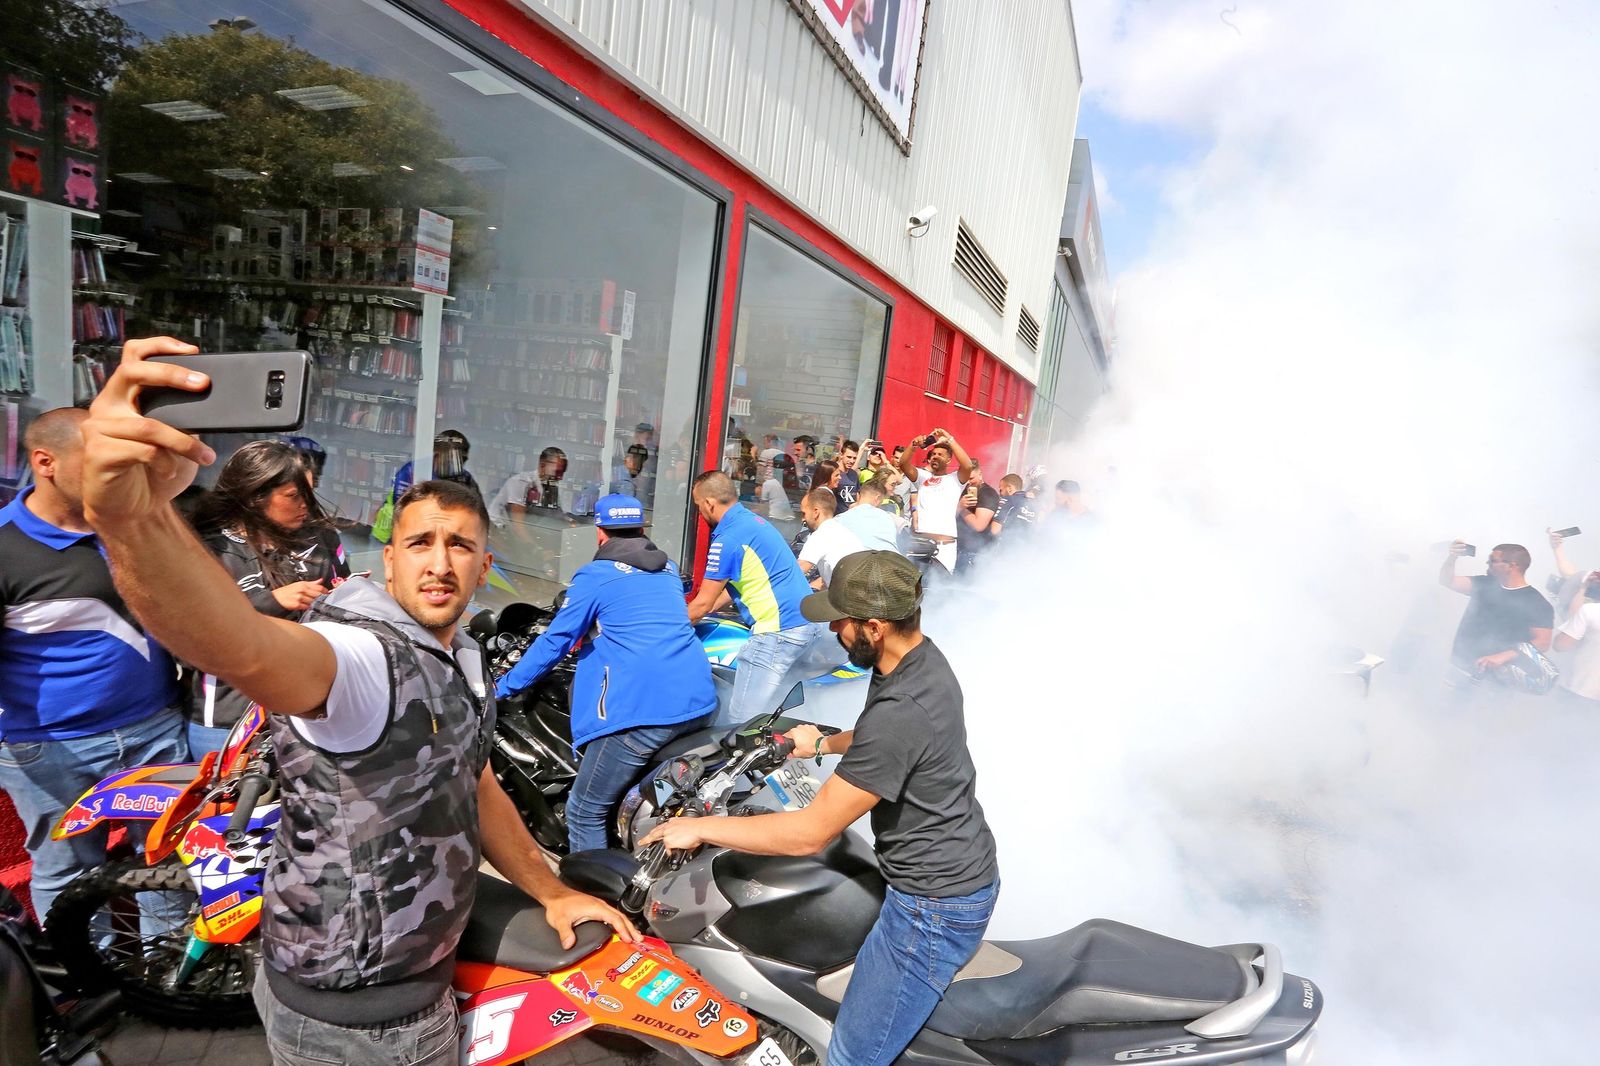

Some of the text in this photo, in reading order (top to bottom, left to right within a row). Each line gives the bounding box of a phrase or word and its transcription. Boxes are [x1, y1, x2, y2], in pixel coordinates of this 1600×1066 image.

[777, 760, 810, 790] 4948
[111, 793, 147, 811] Red
[793, 782, 817, 809] JNB
[217, 909, 246, 929] DHL
[1301, 979, 1314, 1009] SUZUKI
[631, 1013, 700, 1040] DUNLOP
